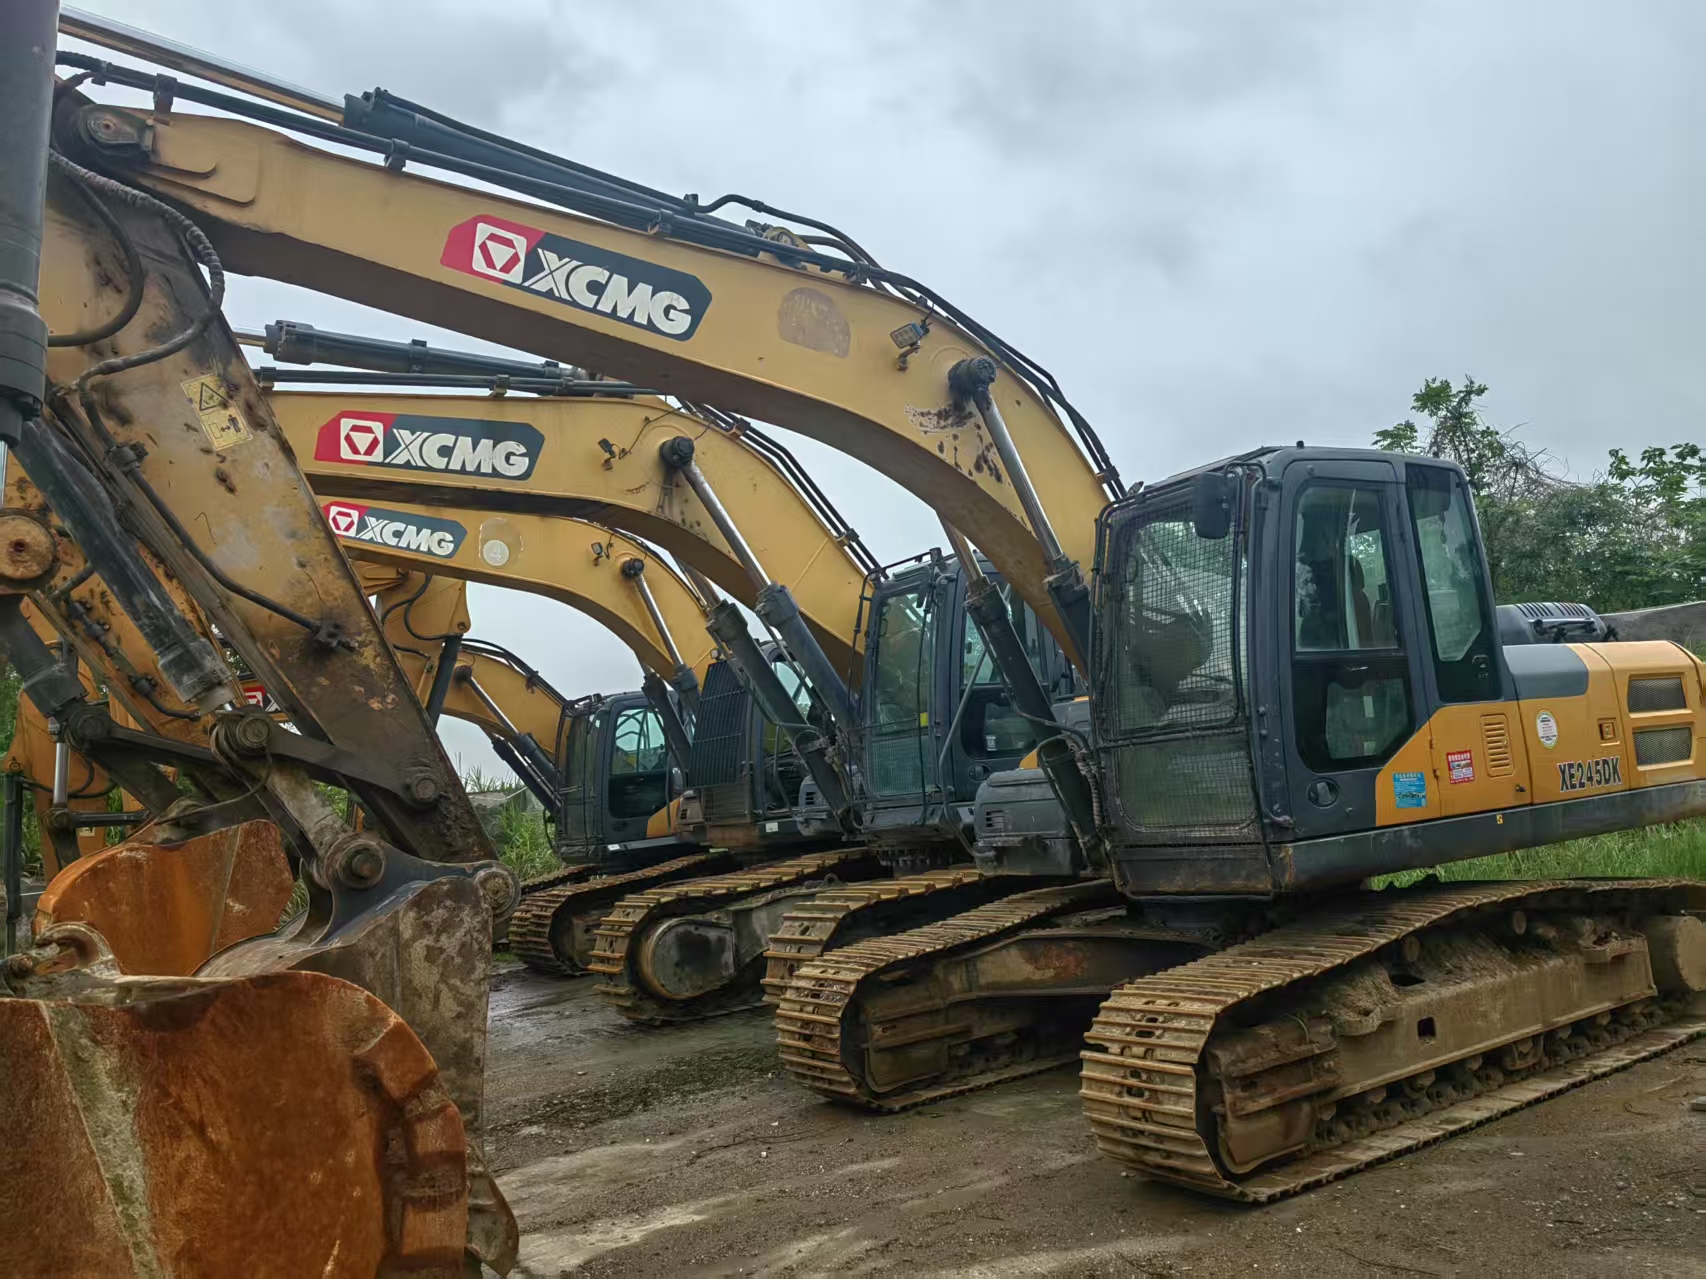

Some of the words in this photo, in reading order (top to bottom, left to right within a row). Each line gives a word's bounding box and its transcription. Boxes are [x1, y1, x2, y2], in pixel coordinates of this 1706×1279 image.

[521, 248, 692, 335] XCMG
[384, 428, 529, 477] XCMG
[356, 515, 455, 556] XCMG
[1557, 757, 1621, 792] XE245DK
